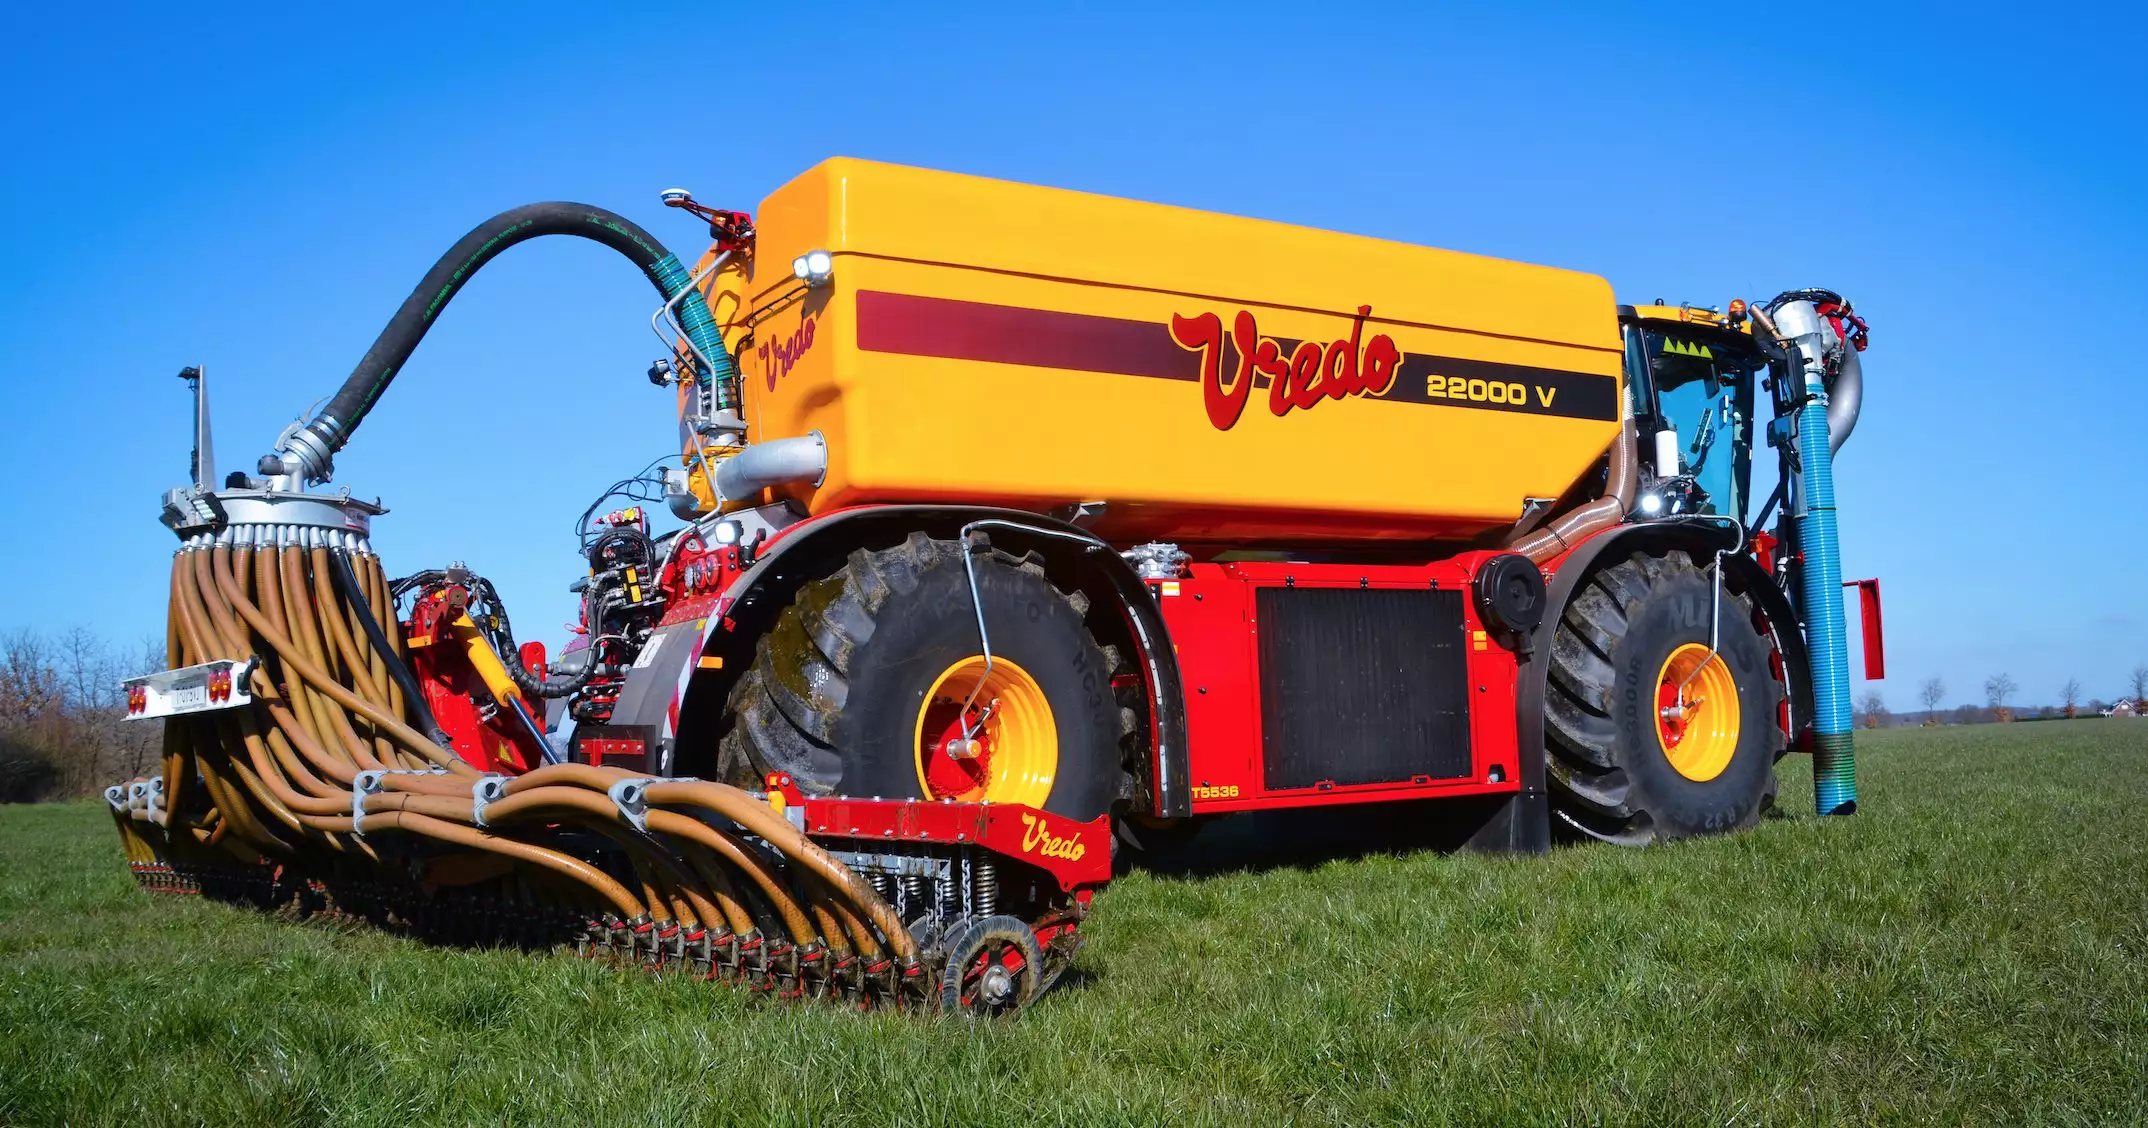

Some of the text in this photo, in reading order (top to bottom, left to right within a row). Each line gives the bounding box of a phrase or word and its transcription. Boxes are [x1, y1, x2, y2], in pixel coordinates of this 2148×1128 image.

[758, 316, 816, 393] Vredo
[1172, 304, 1399, 432] Vredo
[1426, 374, 1557, 408] 22000 V
[1021, 811, 1085, 862] Vredo
